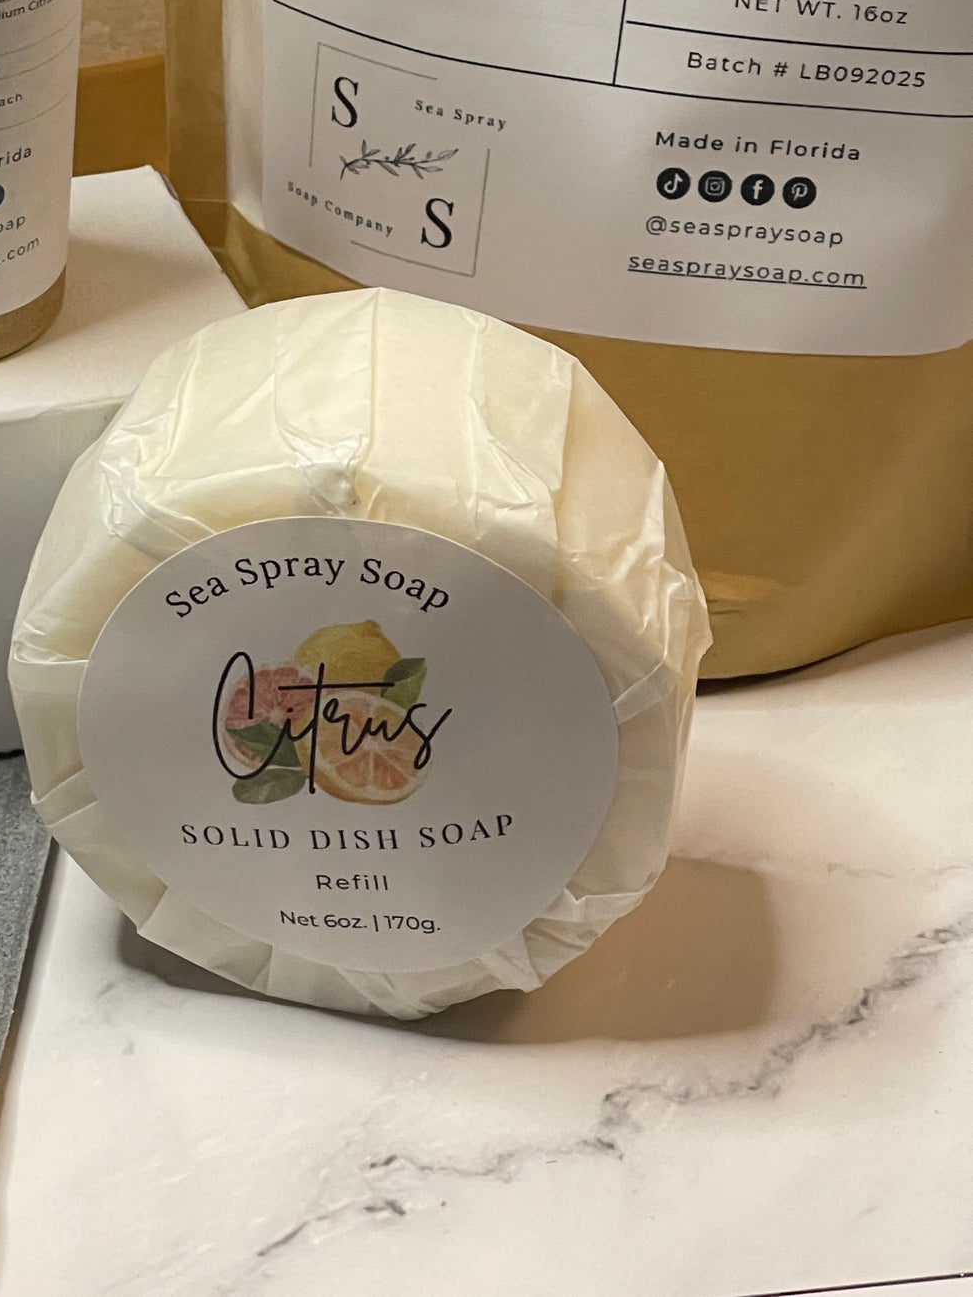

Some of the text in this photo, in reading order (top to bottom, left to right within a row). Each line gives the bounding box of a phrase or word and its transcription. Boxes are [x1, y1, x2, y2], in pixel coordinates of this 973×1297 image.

[797, 0, 840, 18] WT.
[854, 4, 907, 24] 16oz
[688, 52, 925, 87] Batch # LB092025
[332, 77, 358, 128] S
[415, 100, 506, 131] Sea Spray
[656, 132, 859, 160] Made in Florida
[288, 182, 393, 237] Soap Company
[421, 198, 454, 248] S
[646, 216, 843, 248] @seaspraysoap
[628, 257, 867, 289] seaspraysoap.com
[166, 558, 448, 617] Sea Spray Soap
[212, 652, 452, 793] Citrus
[182, 815, 512, 849] SOLID DISH SOAP
[316, 875, 388, 890] Refill
[280, 911, 440, 934] Net 6oz. 170g.
